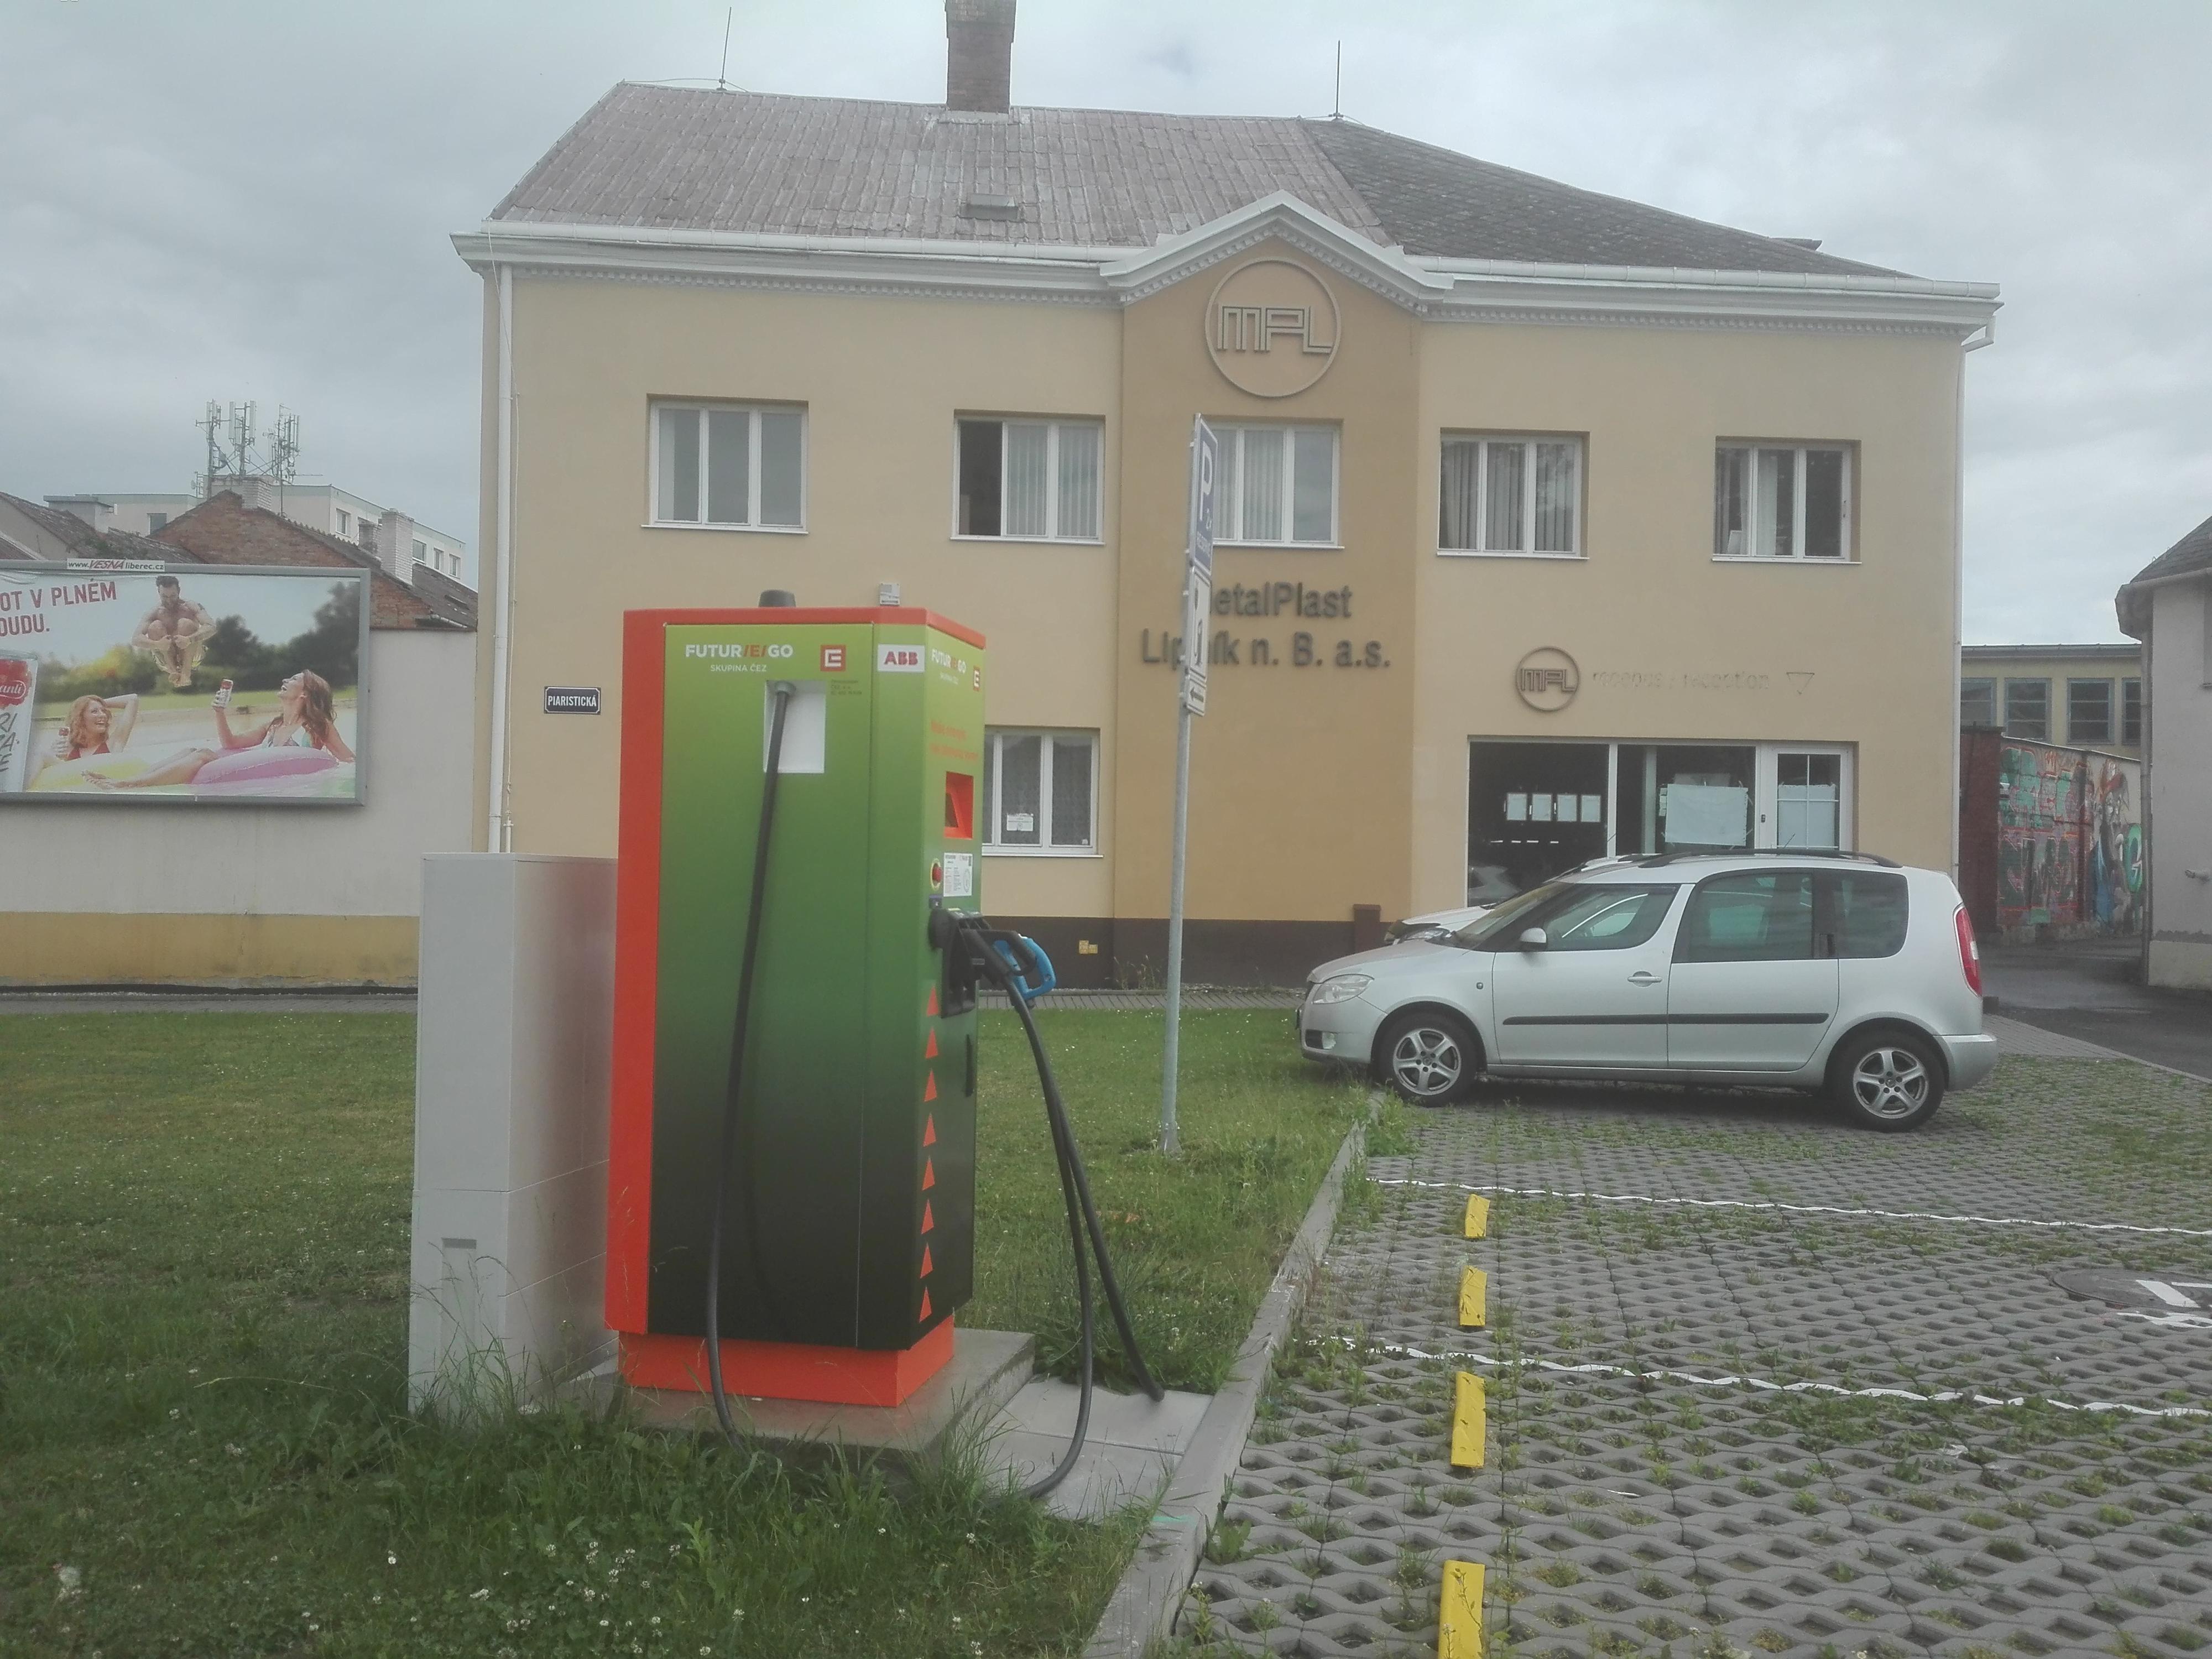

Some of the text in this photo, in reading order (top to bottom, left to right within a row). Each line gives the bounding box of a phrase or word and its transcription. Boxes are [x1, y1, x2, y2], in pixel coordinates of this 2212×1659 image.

[1217, 303, 1333, 354] MPL
[1200, 441, 1213, 521] P
[30, 588, 42, 608] V
[51, 578, 117, 606] PLNÉM
[1209, 581, 1353, 617] etalPlast
[884, 650, 919, 666] ABB
[1251, 638, 1279, 667] n.
[1293, 631, 1324, 667] B.
[1335, 639, 1391, 668] a.s.
[710, 661, 768, 672] SKUPINA ČEZ
[1520, 667, 1578, 692] MPL
[548, 695, 597, 707] PIARISTICKÁ
